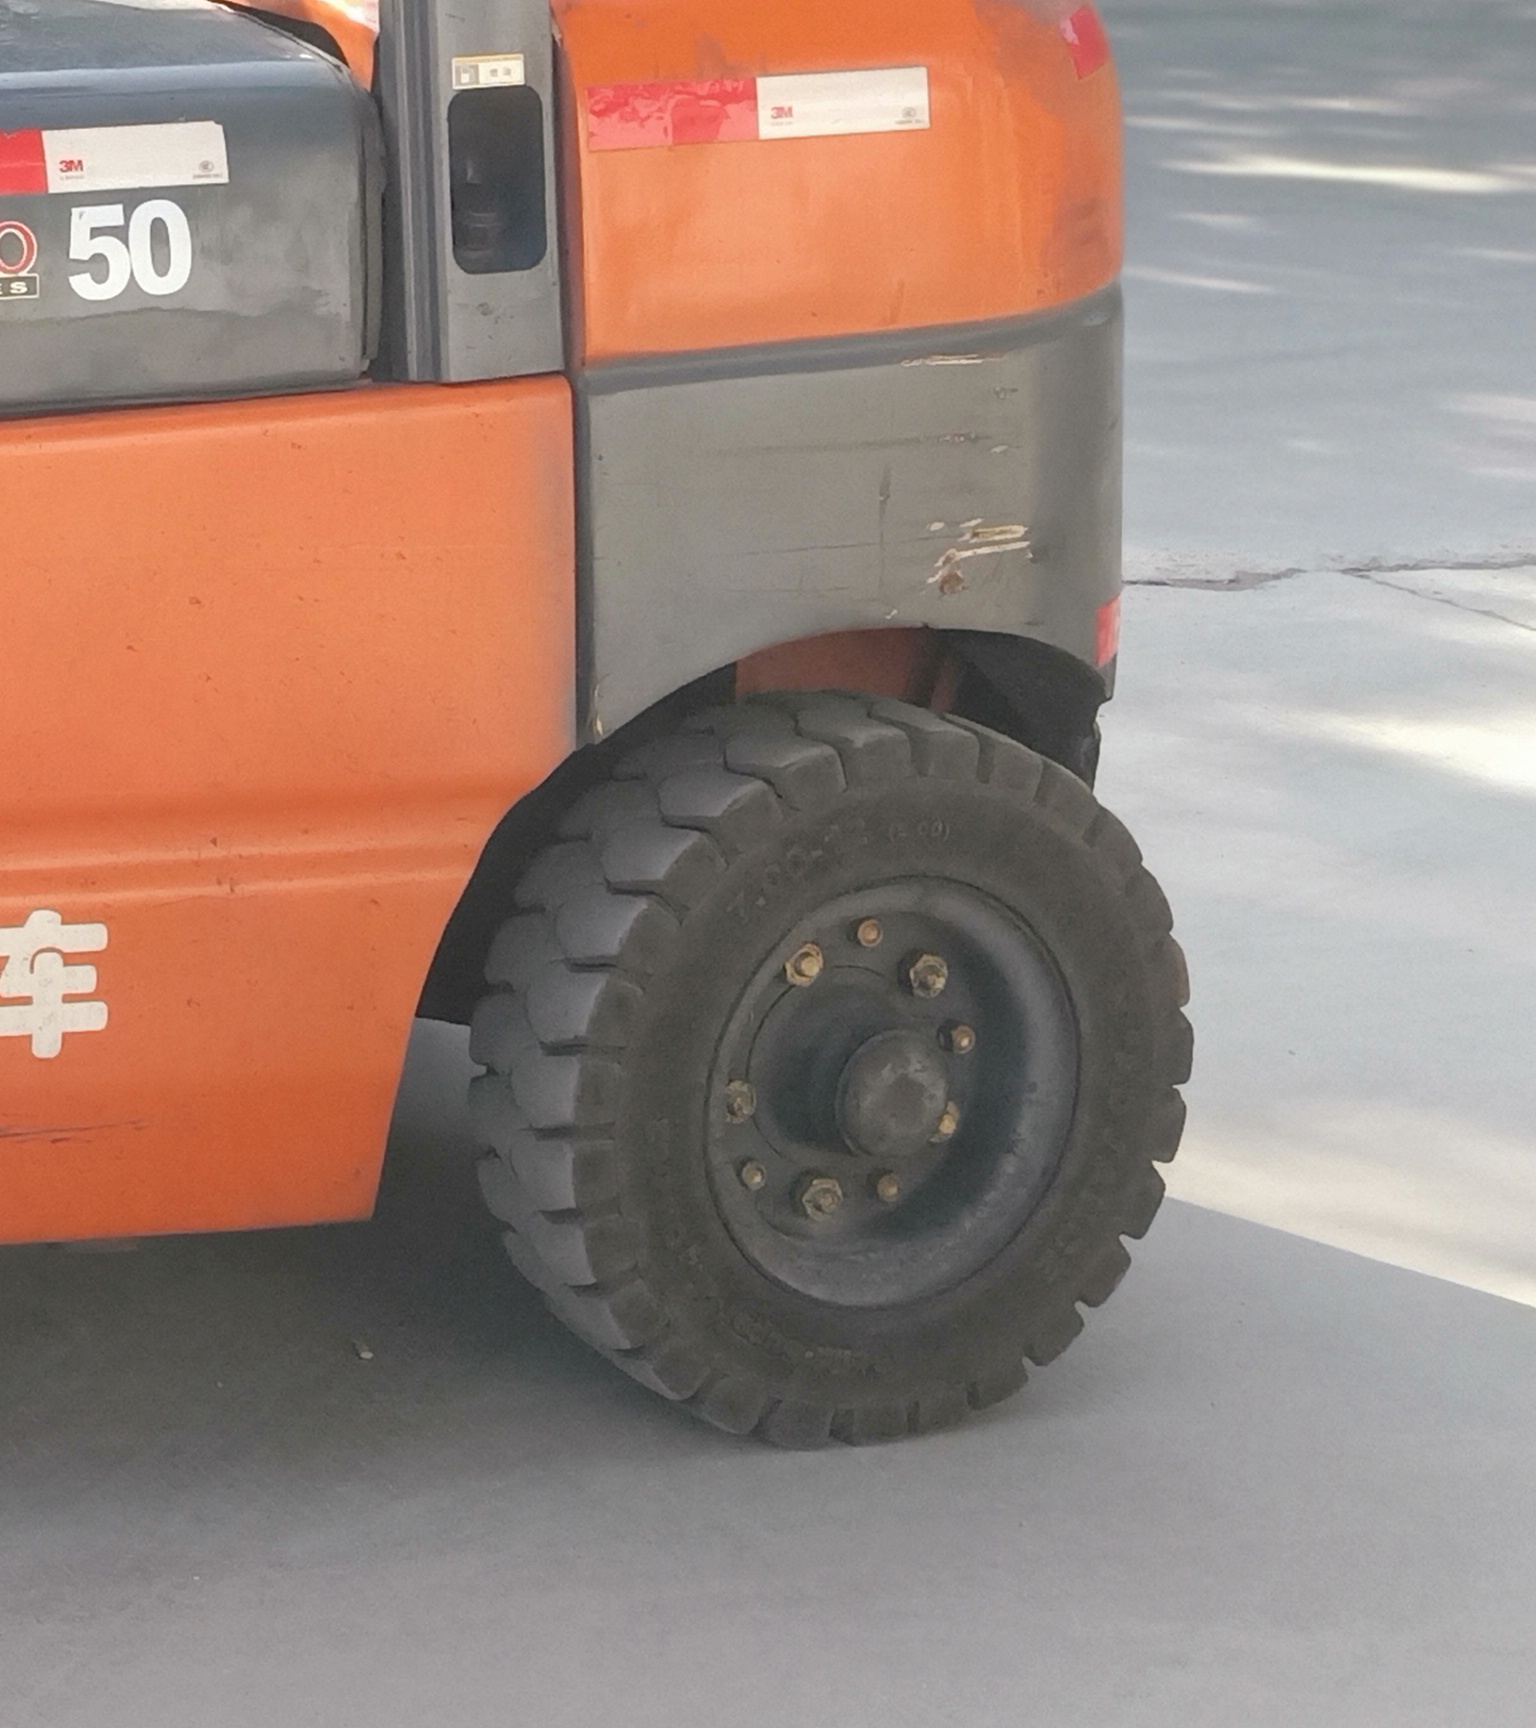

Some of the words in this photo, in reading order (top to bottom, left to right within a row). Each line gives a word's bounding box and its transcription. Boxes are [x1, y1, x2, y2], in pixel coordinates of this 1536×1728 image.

[770, 106, 794, 119] 3M
[59, 159, 84, 173] 3M
[68, 199, 192, 301] 50
